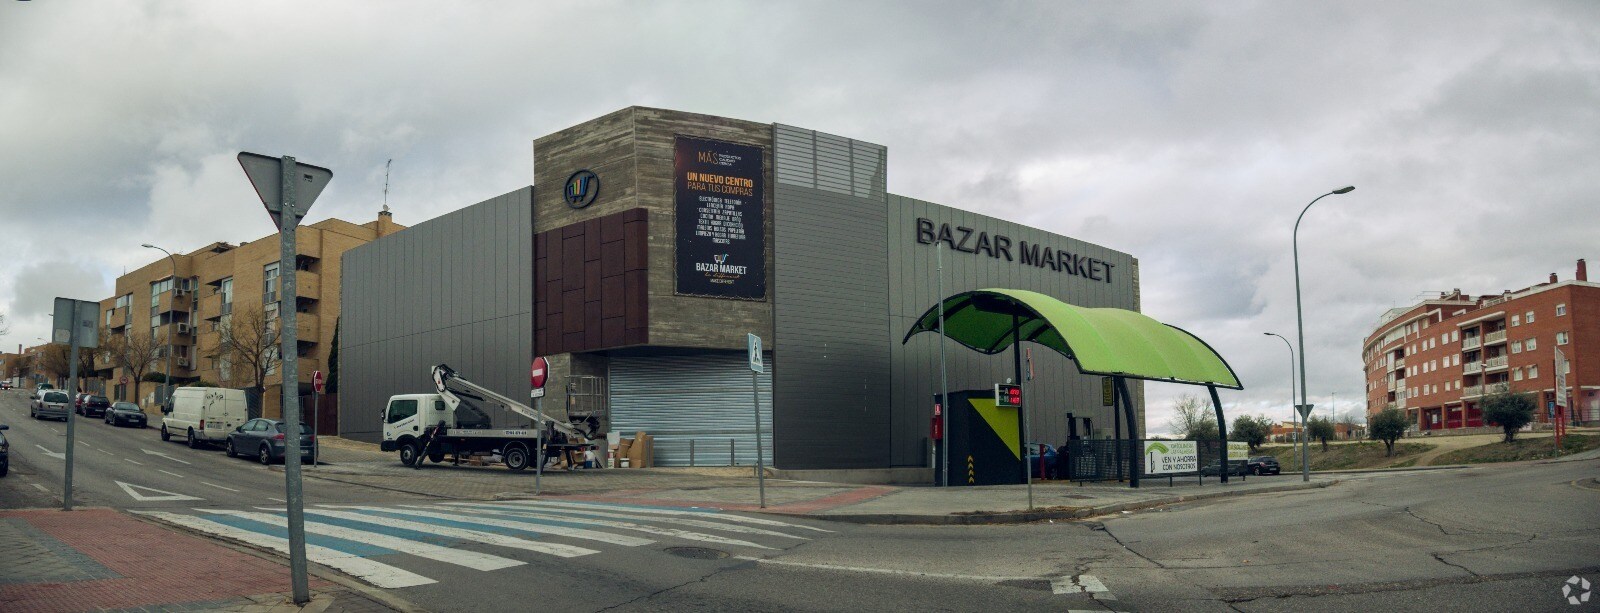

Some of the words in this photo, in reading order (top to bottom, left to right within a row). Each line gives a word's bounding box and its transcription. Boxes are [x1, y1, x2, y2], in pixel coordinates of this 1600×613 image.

[687, 171, 698, 182] UN
[699, 173, 724, 184] NUEVO
[725, 176, 753, 188] CENTRO
[687, 181, 706, 191] PARA
[708, 183, 720, 193] TUS
[721, 185, 753, 196] COMPRAS
[916, 217, 1013, 262] BAZAR
[1020, 240, 1115, 283] MARKET
[695, 262, 719, 272] BAZAR
[719, 264, 747, 275] MARKET
[1177, 455, 1197, 463] AHORRA
